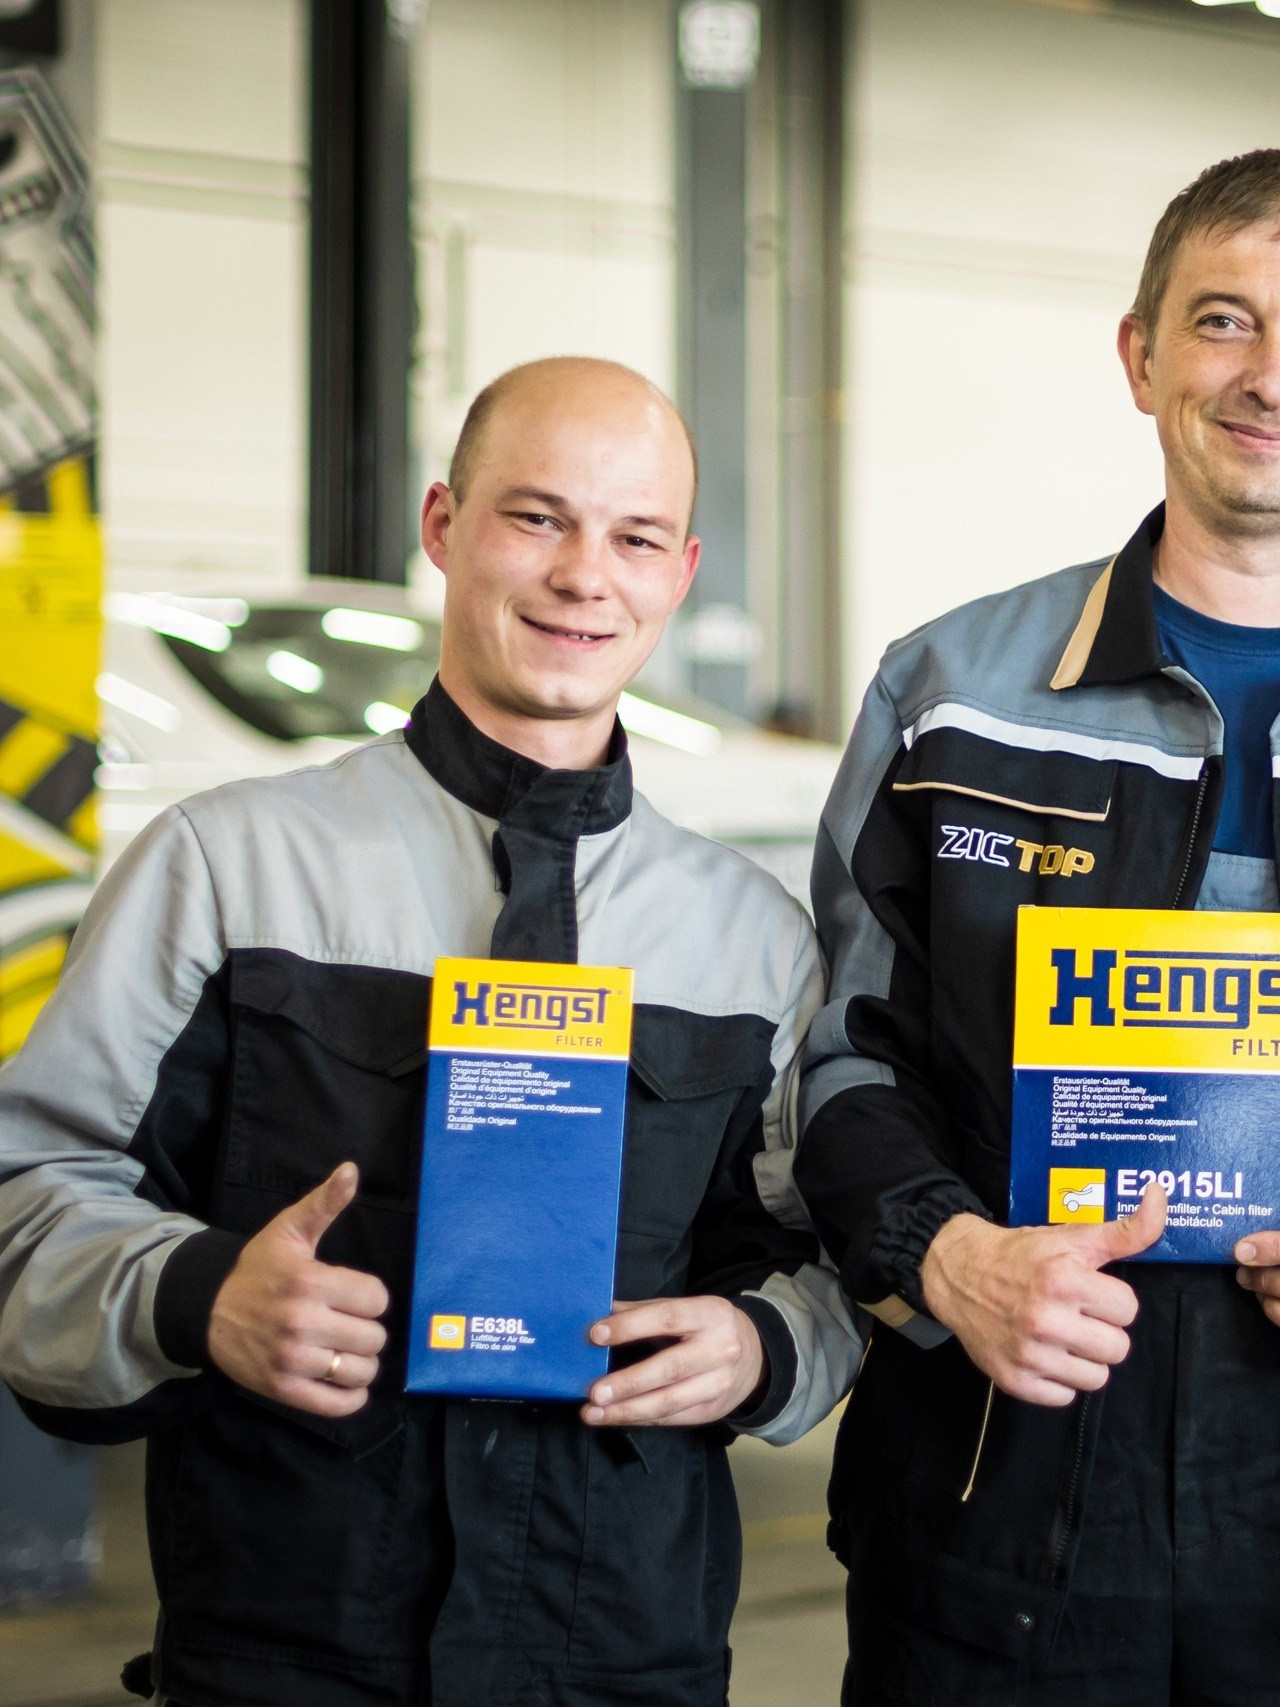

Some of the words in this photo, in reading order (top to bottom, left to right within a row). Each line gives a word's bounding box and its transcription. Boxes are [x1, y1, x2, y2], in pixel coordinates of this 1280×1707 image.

[451, 981, 612, 1030] Hengst
[556, 1035, 603, 1047] FILTER
[451, 1067, 480, 1077] Original
[482, 1068, 522, 1078] Equipment
[523, 1070, 549, 1080] Quality
[450, 1075, 479, 1083] Calidad
[480, 1076, 490, 1084] de
[492, 1077, 542, 1087] equipamiento
[543, 1079, 571, 1089] original
[1053, 1084, 1080, 1094] Original
[1082, 1085, 1120, 1095] Equipment
[1121, 1086, 1146, 1095] Quality
[449, 1098, 486, 1108] Качество
[1081, 1093, 1091, 1101] de
[1092, 1094, 1140, 1102] equipamiento
[1141, 1095, 1167, 1103] original
[448, 1114, 486, 1125] Qualidade
[487, 1116, 516, 1127] Original
[1052, 1115, 1088, 1123] Качество
[1051, 1131, 1088, 1140] Qualidade
[1089, 1132, 1099, 1140] de
[1100, 1132, 1147, 1142] Equipamento
[1148, 1133, 1176, 1142] Original
[1117, 1169, 1243, 1198] E2915LI
[1212, 1204, 1245, 1215] Cabin
[1248, 1205, 1272, 1216] filter
[1165, 1215, 1223, 1227] habitáculo
[471, 1317, 529, 1335] E638L
[471, 1334, 500, 1343] Luftfilter
[519, 1336, 535, 1344] filter
[470, 1342, 489, 1350] Filtro
